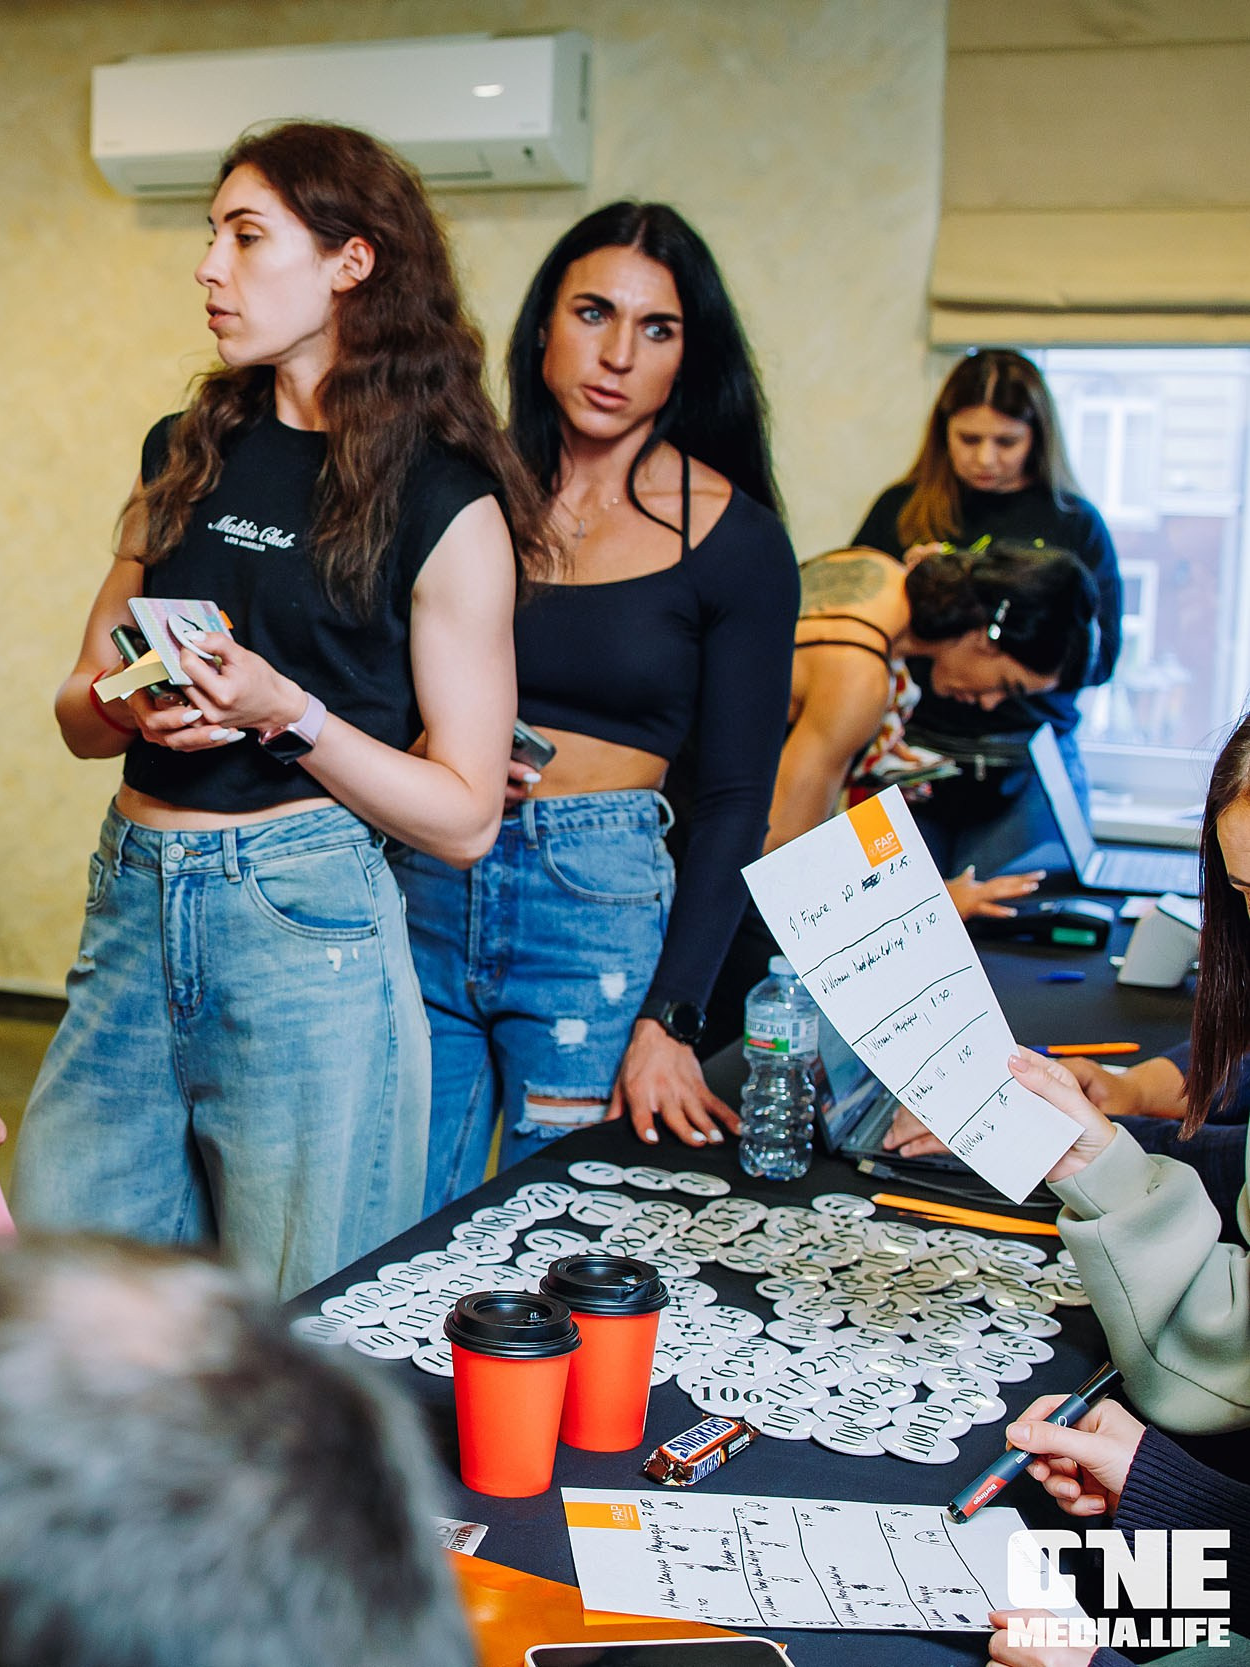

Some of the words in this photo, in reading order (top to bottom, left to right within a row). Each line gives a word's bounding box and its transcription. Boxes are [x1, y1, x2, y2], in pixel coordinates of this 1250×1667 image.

[874, 831, 895, 852] FAP
[533, 1231, 584, 1250] 91
[709, 1307, 748, 1333] 145
[355, 1330, 409, 1351] 101
[783, 1355, 841, 1379] 127
[974, 1350, 1015, 1376] 149
[701, 1386, 764, 1404] 106
[764, 1376, 817, 1401] 117
[849, 1375, 907, 1400] 128
[761, 1404, 807, 1434] 107
[826, 1397, 880, 1421] 118
[909, 1404, 954, 1433] 119
[666, 1417, 733, 1459] SNICKERS
[829, 1422, 875, 1447] 108
[899, 1427, 939, 1458] 109
[612, 1504, 623, 1521] FAP
[450, 1528, 474, 1551] CENTER
